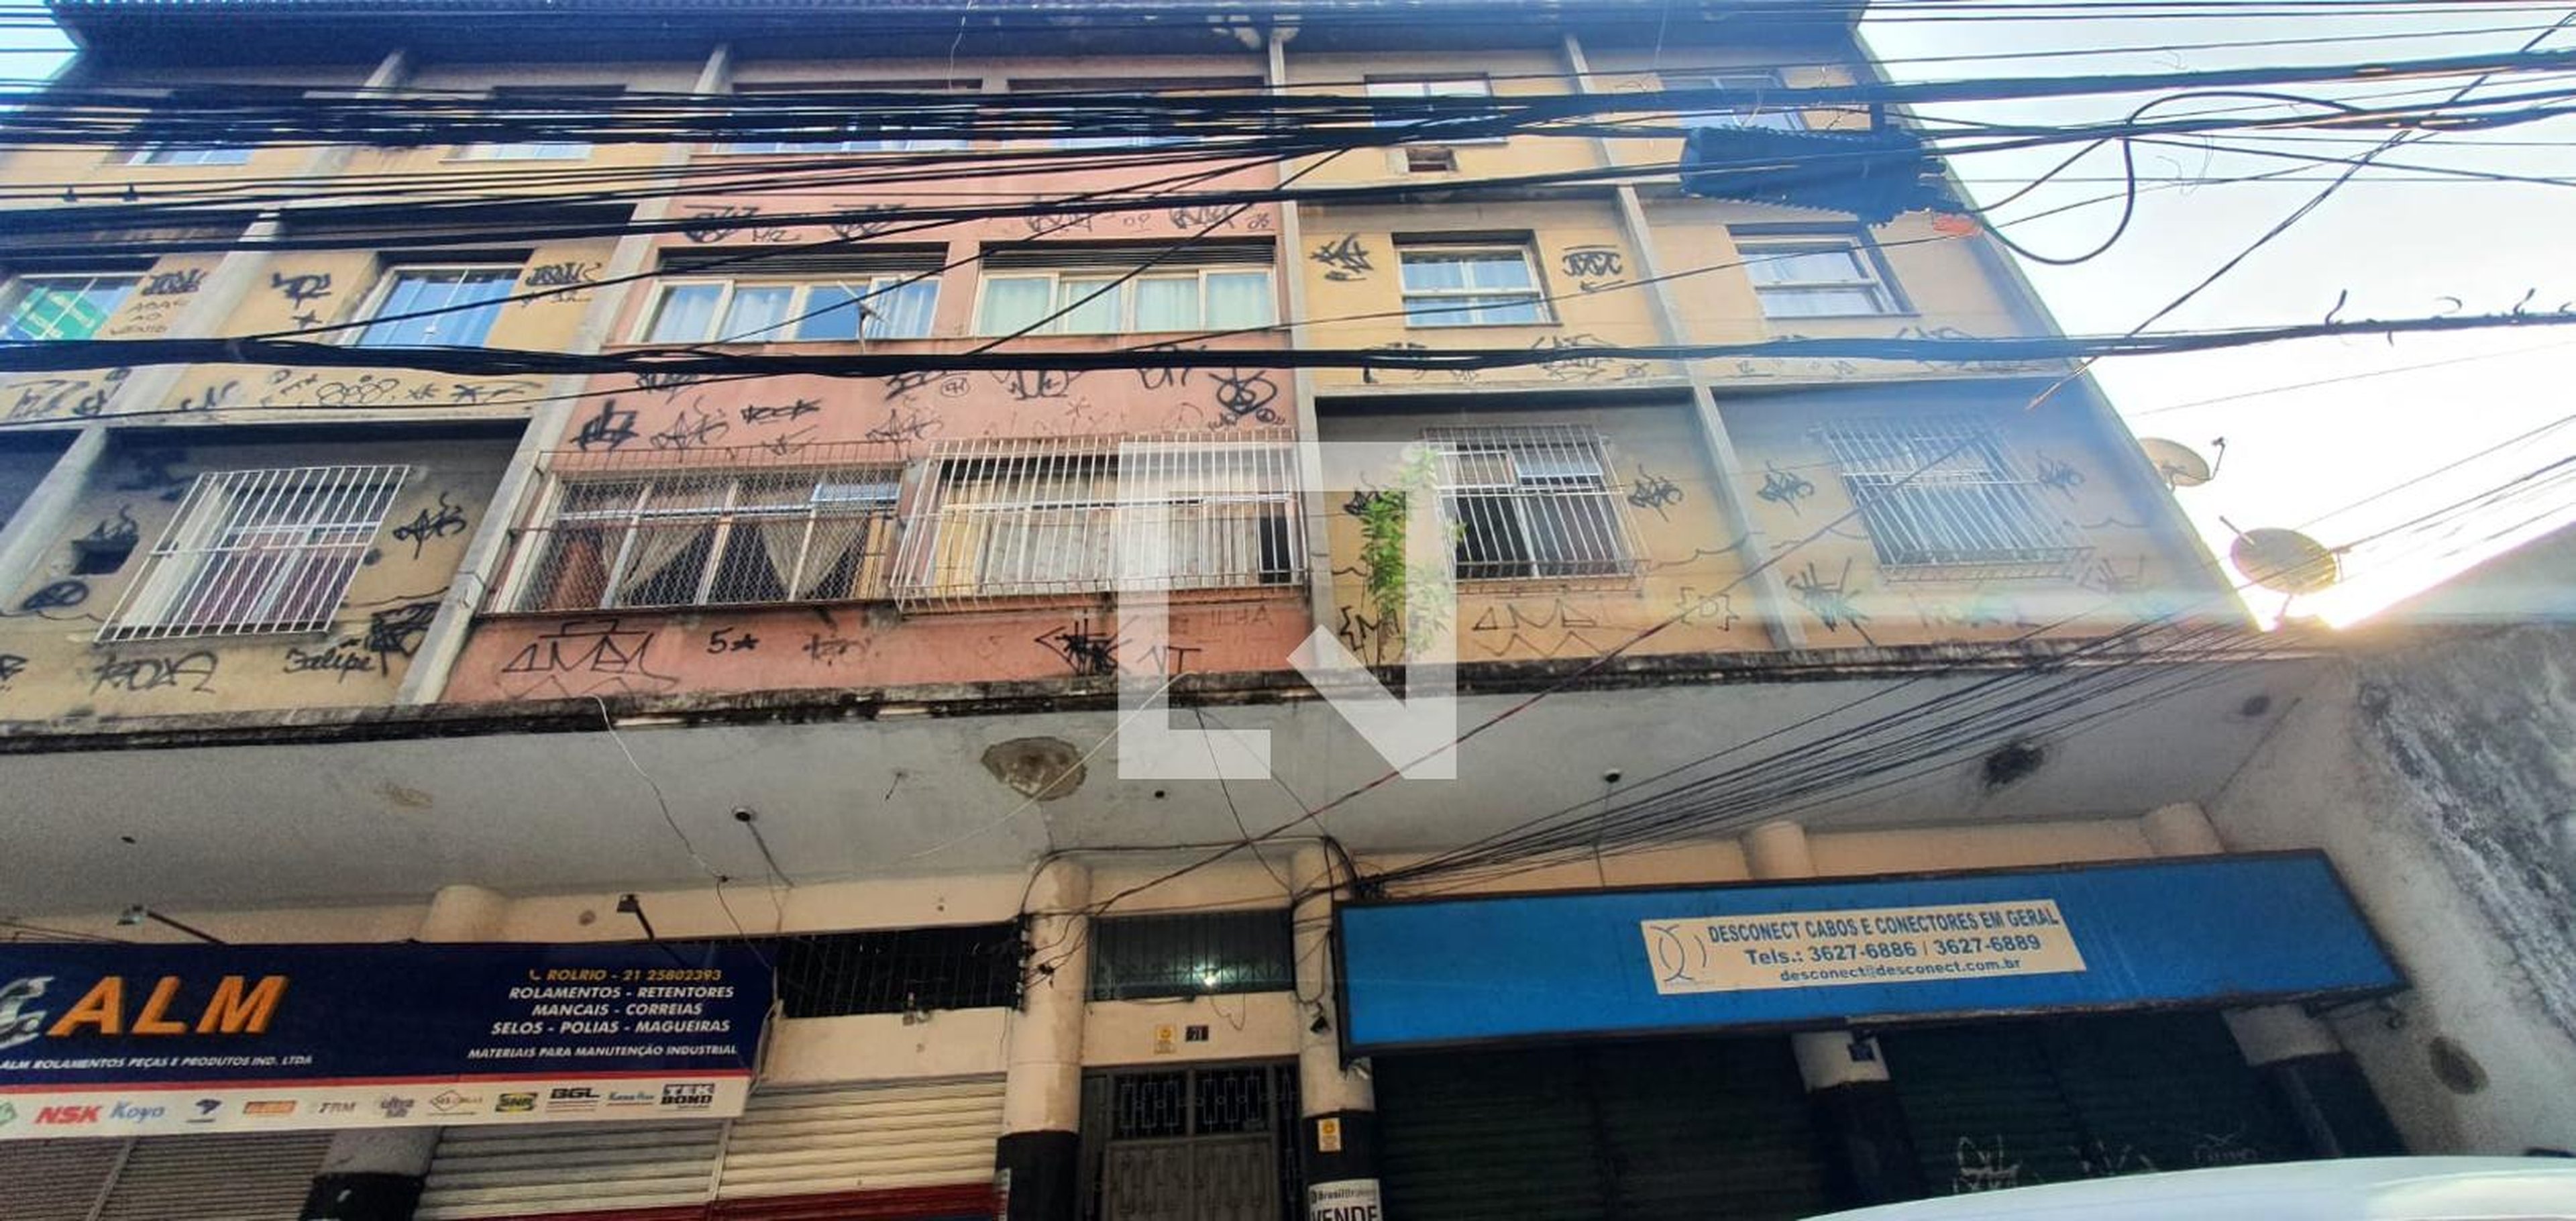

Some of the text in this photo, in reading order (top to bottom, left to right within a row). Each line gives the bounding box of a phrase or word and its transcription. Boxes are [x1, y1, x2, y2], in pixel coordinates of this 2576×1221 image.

[1707, 907, 2059, 943] DESCONECT CABOS E CONECTORES EM GERAL
[1743, 948, 1805, 965] Tels.:
[1808, 941, 1917, 963] 3627-6886
[1933, 935, 2041, 956] 3627-6889
[546, 969, 608, 981] ROLRIO
[622, 969, 641, 981] 21
[1780, 959, 2022, 981] desconect@desconect.com.br
[508, 986, 621, 1000] ROLAMENTOS
[636, 986, 734, 999] RETENTORES
[46, 975, 289, 1037] ALM
[531, 1003, 609, 1016] MANCAIS
[625, 1002, 703, 1016] CORREIAS
[490, 1021, 543, 1035] SELOS
[559, 1020, 620, 1034] POLIAS
[634, 1019, 731, 1033] MAGUEIRAS
[467, 1043, 737, 1059] MATERIAIS PARA MANUTENÇÃO INDUSTRIAL
[32, 1057, 125, 1069] ROLAMENTOS
[127, 1057, 168, 1071] PEÇAS
[180, 1056, 250, 1067] PRODUTOS
[281, 1055, 313, 1065] LTDA
[549, 1087, 601, 1100] BGL
[34, 1105, 103, 1124] NSK
[109, 1100, 166, 1124] Koyo
[1310, 1205, 1379, 1221] VENDE
